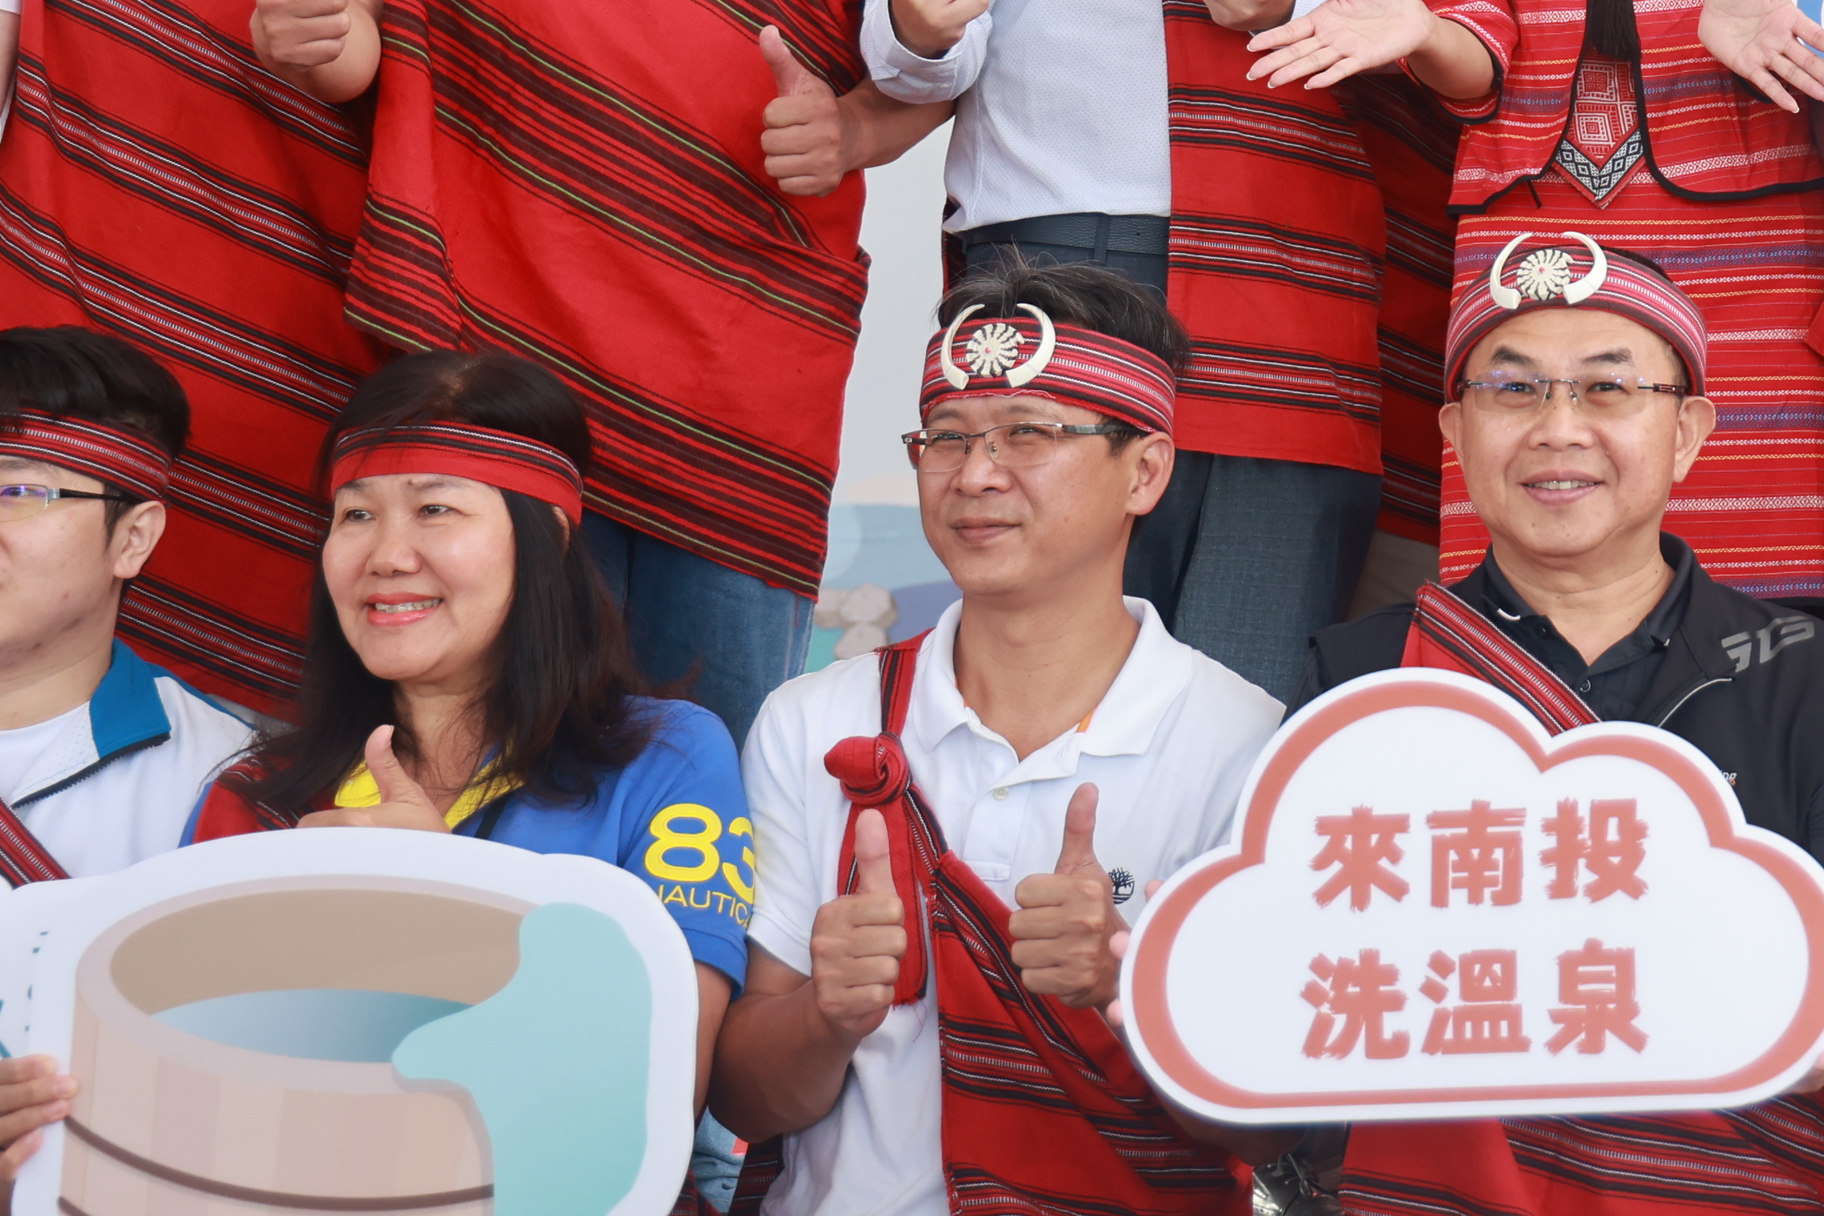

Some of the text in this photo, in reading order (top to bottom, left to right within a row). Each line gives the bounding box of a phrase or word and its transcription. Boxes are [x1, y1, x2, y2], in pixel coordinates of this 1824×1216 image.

[1309, 797, 1650, 912] 來南投
[1300, 938, 1650, 1061] 洗溫泉
